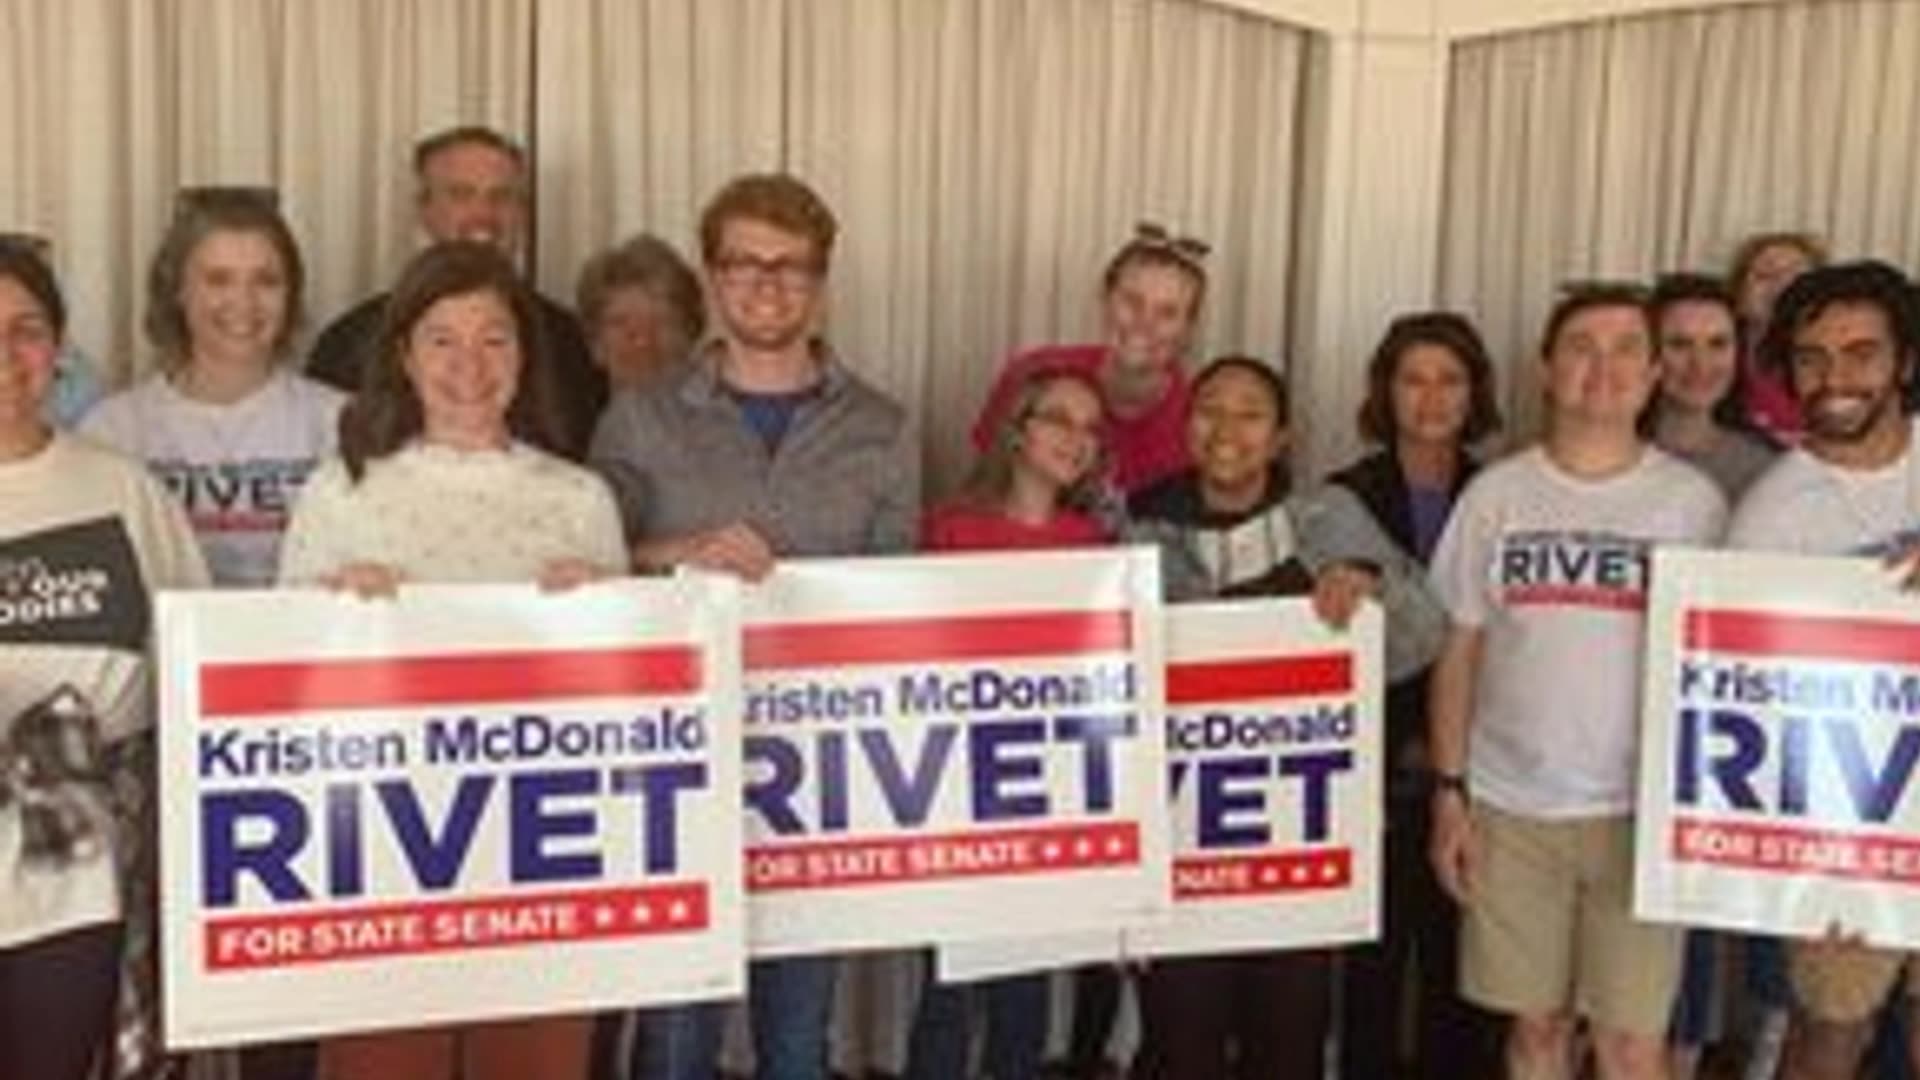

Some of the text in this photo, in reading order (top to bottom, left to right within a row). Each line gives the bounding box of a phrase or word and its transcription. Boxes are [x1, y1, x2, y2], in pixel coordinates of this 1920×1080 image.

[743, 682, 883, 724] risten
[199, 709, 707, 778] Kristen McDonald
[743, 716, 1138, 835] RIVET
[200, 762, 709, 908] RIVET
[806, 847, 899, 880] STATE
[907, 839, 1031, 875] SENATE
[1685, 829, 1756, 861] FOR
[216, 903, 578, 962] FOR STATE SENATE
